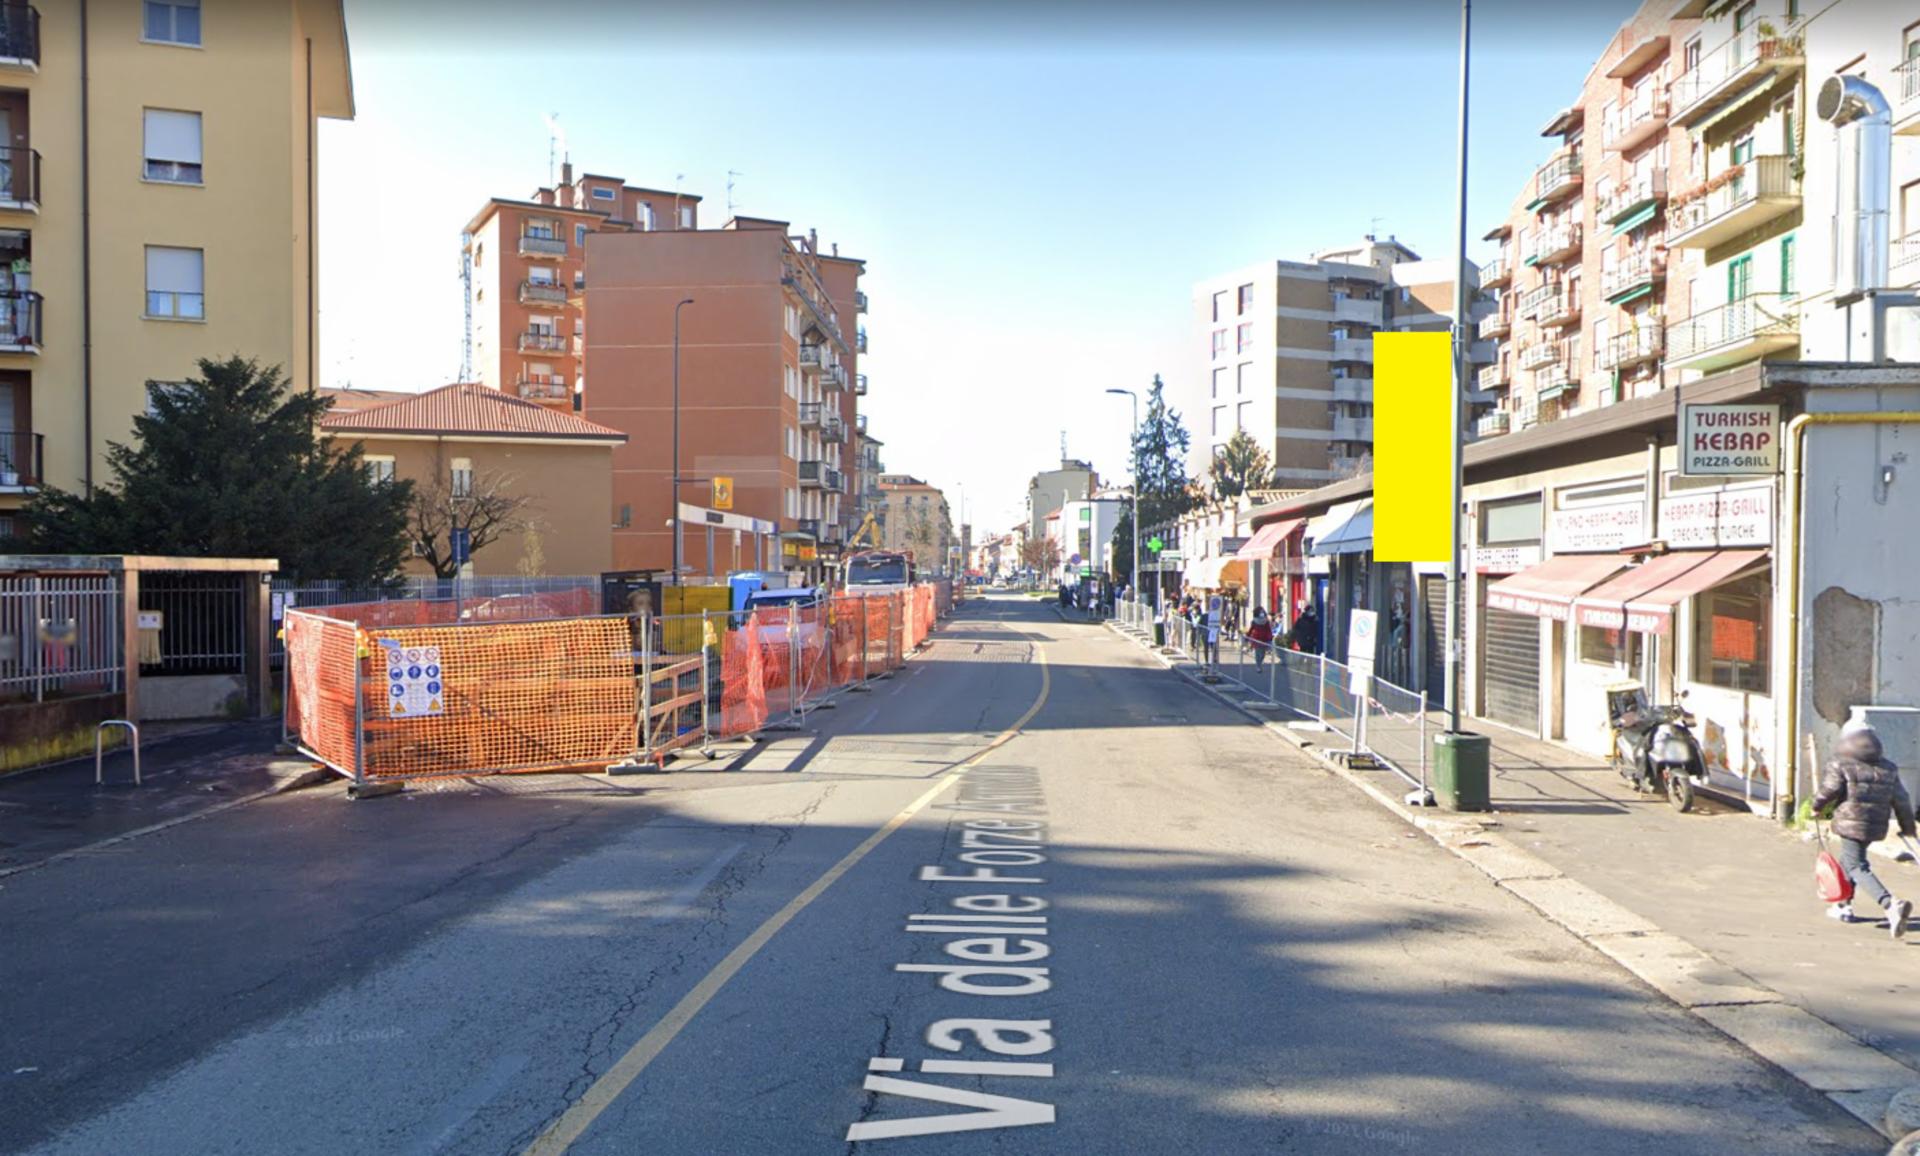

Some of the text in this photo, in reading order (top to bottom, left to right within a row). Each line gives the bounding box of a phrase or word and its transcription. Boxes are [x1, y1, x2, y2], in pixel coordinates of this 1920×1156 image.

[1695, 412, 1771, 427] TURKISH
[1694, 432, 1771, 451] KEBAP
[1693, 456, 1771, 467] PIZZA-GRILL
